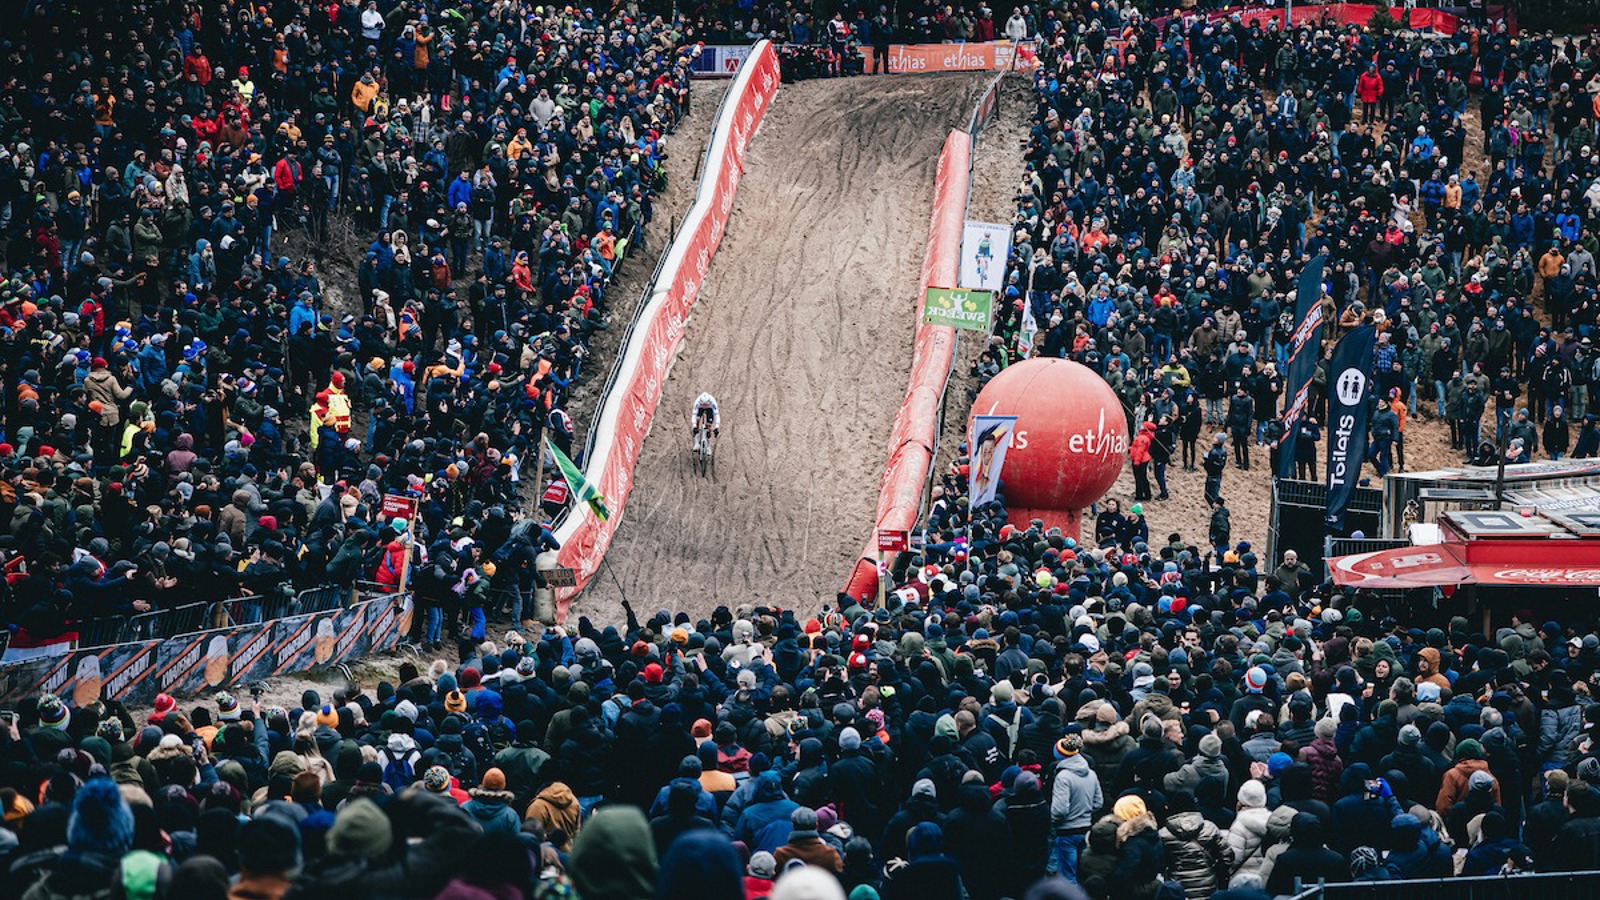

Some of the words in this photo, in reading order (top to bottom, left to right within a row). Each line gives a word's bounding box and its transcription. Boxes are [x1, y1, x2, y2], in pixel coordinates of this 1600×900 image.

[944, 43, 985, 70] ethias
[1069, 407, 1128, 462] ethias
[1330, 414, 1355, 491] Toilets
